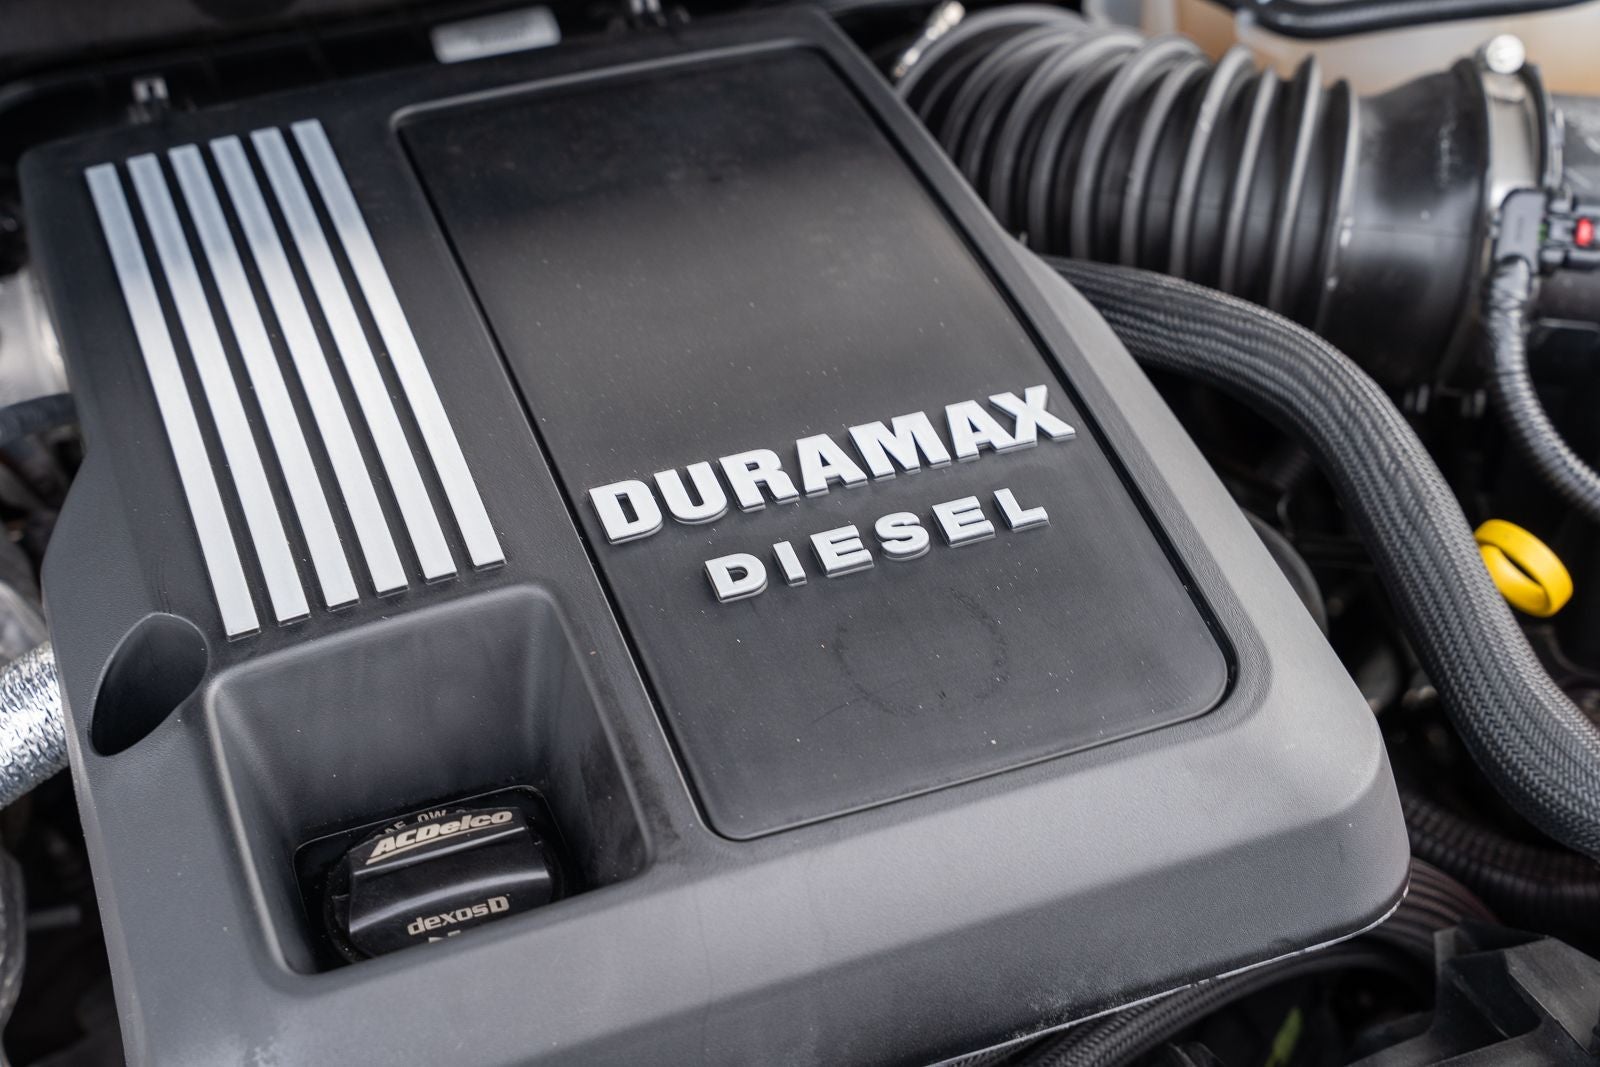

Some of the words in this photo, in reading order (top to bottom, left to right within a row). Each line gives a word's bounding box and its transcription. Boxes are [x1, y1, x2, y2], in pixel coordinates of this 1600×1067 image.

[588, 384, 1076, 544] DURAMAX
[704, 488, 1050, 603] DIESEL
[368, 811, 513, 859] ACDelco
